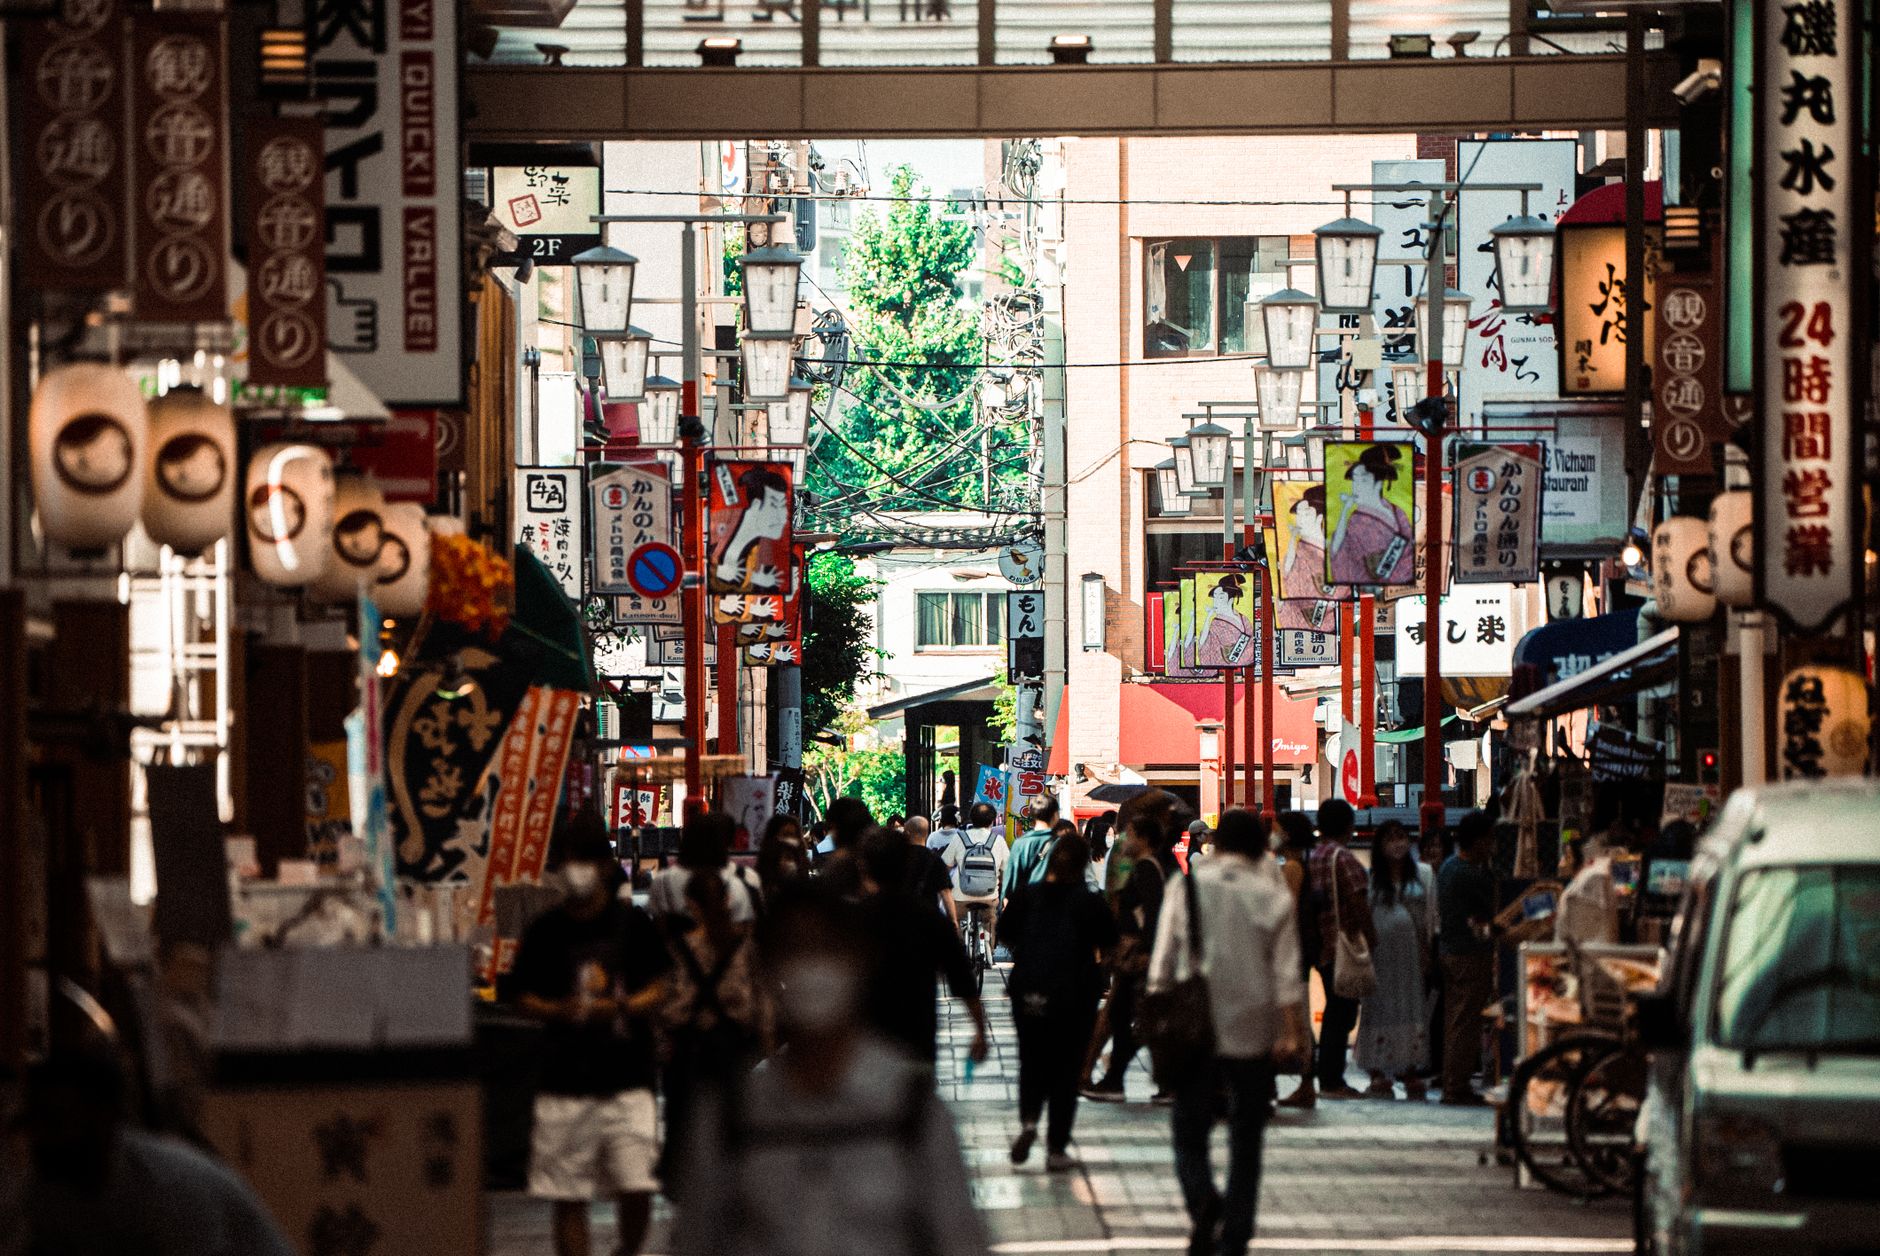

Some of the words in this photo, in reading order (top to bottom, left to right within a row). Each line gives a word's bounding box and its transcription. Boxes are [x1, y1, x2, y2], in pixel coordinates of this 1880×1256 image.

[406, 65, 431, 183] QUICK!
[1779, 0, 1837, 266] 磯丸水産
[146, 33, 217, 301] 観音通り
[257, 137, 319, 368] 観音通り
[532, 238, 562, 256] 2F
[1510, 336, 1536, 344] GUNMA
[1661, 287, 1706, 462] 観音通り
[1779, 300, 1836, 576] 24時間営業
[1554, 448, 1596, 473] Vietnam
[532, 481, 563, 504] 牛角
[1500, 460, 1522, 567] かんのん通り
[1018, 594, 1036, 639] もん
[1405, 615, 1506, 645] すし栄
[1271, 738, 1309, 755] Omiya
[983, 776, 1003, 801] 氷
[1018, 770, 1045, 796] ち
